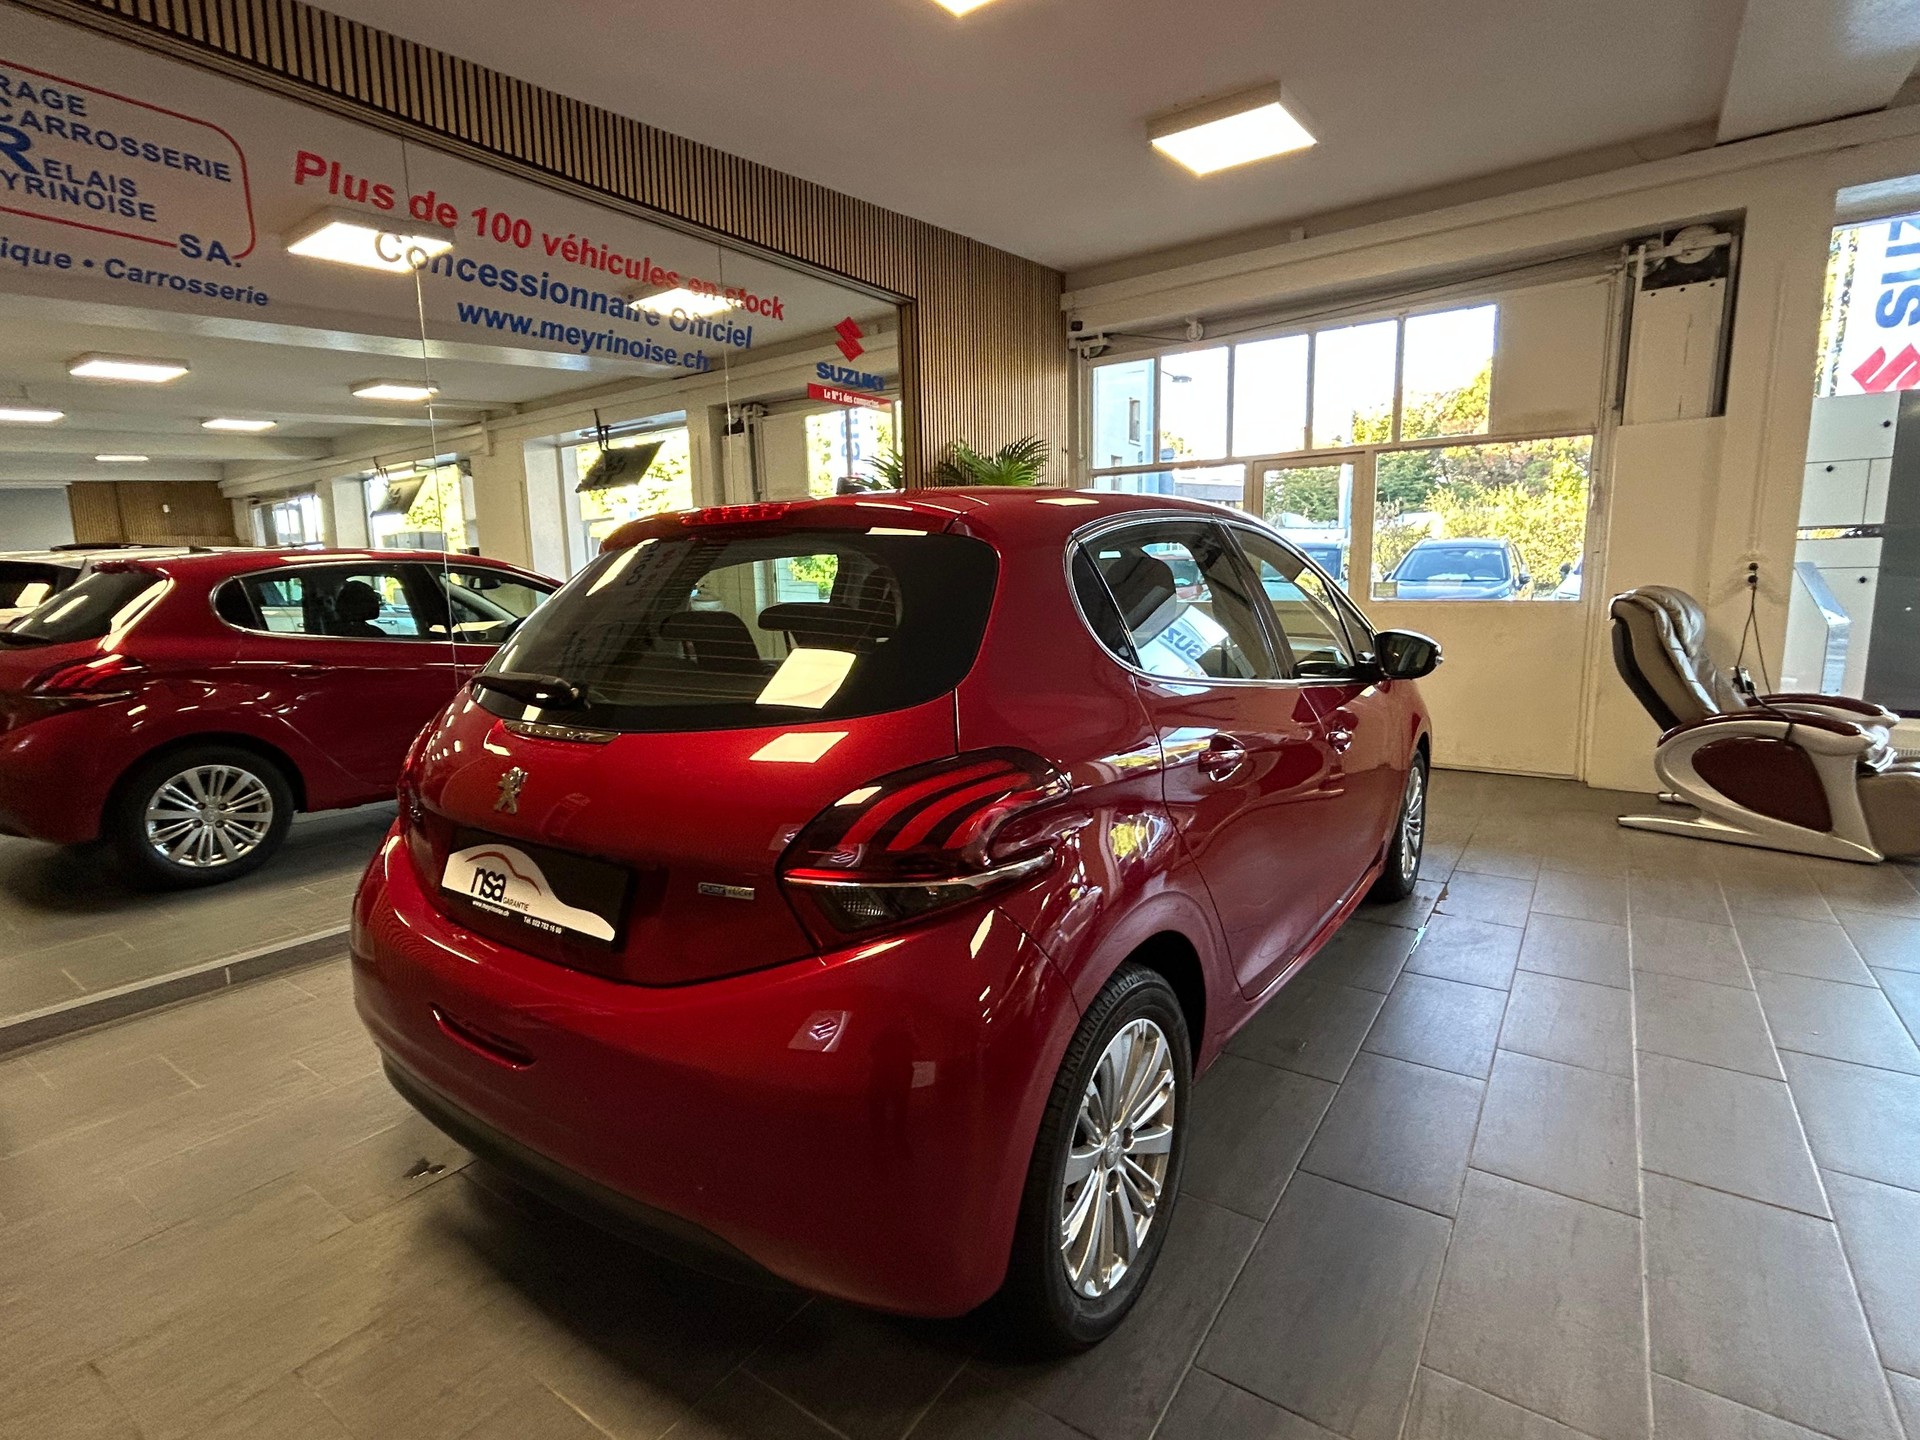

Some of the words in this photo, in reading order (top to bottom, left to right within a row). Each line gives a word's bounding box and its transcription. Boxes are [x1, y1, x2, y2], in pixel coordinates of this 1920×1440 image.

[295, 150, 395, 210] Plus
[409, 190, 459, 228] de
[472, 207, 532, 248] 100
[542, 233, 680, 288] véhicules
[179, 233, 242, 268] SA.
[105, 258, 269, 307] Carrosserie
[374, 230, 661, 326] Concessionnaire
[669, 307, 752, 349] Officiel
[457, 302, 711, 371] www.meyrinoise.ch
[470, 867, 507, 902] nsa
[502, 896, 530, 912] GARANTIE
